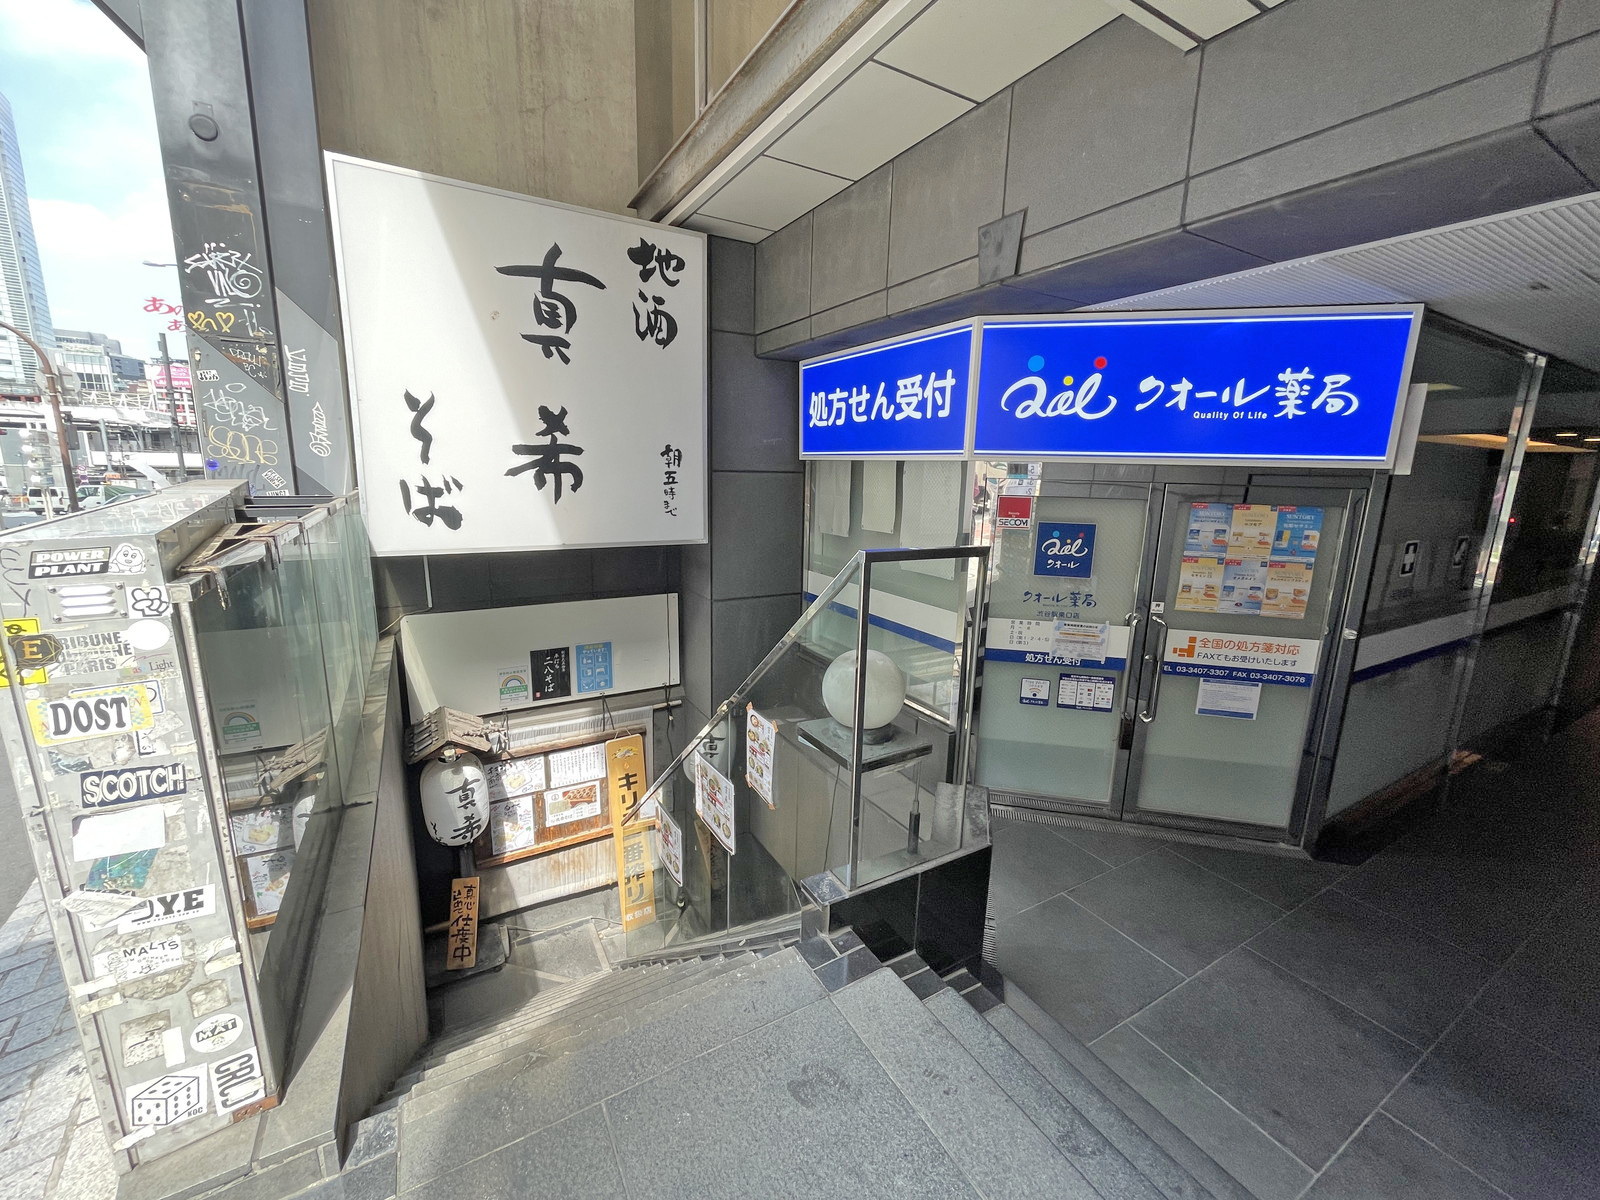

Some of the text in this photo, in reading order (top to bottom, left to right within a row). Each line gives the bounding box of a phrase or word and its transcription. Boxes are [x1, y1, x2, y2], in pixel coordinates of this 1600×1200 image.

[627, 237, 686, 350] 地酒
[494, 242, 607, 505] 真希
[808, 369, 956, 428] 処方せん受付
[1136, 366, 1360, 420] クオール薬局
[1193, 411, 1268, 420] Quality Of Life
[399, 388, 464, 531] そば
[998, 518, 1029, 527] SECOM
[35, 550, 105, 565] POWER
[1046, 559, 1080, 569] クオール
[34, 562, 104, 578] PLANT
[1023, 591, 1097, 608] クオール薬局
[23, 640, 43, 660] E
[1198, 637, 1301, 656] 全国の処方箋対応
[149, 659, 175, 673] Light
[1025, 653, 1081, 666] 処方せん受付
[543, 656, 555, 693] 二八そば
[1176, 667, 1229, 677] 03-3407-3307
[50, 697, 128, 736] DOST
[82, 764, 184, 807] SCOTCH
[445, 777, 483, 841] 真希
[122, 940, 179, 958] MALTS
